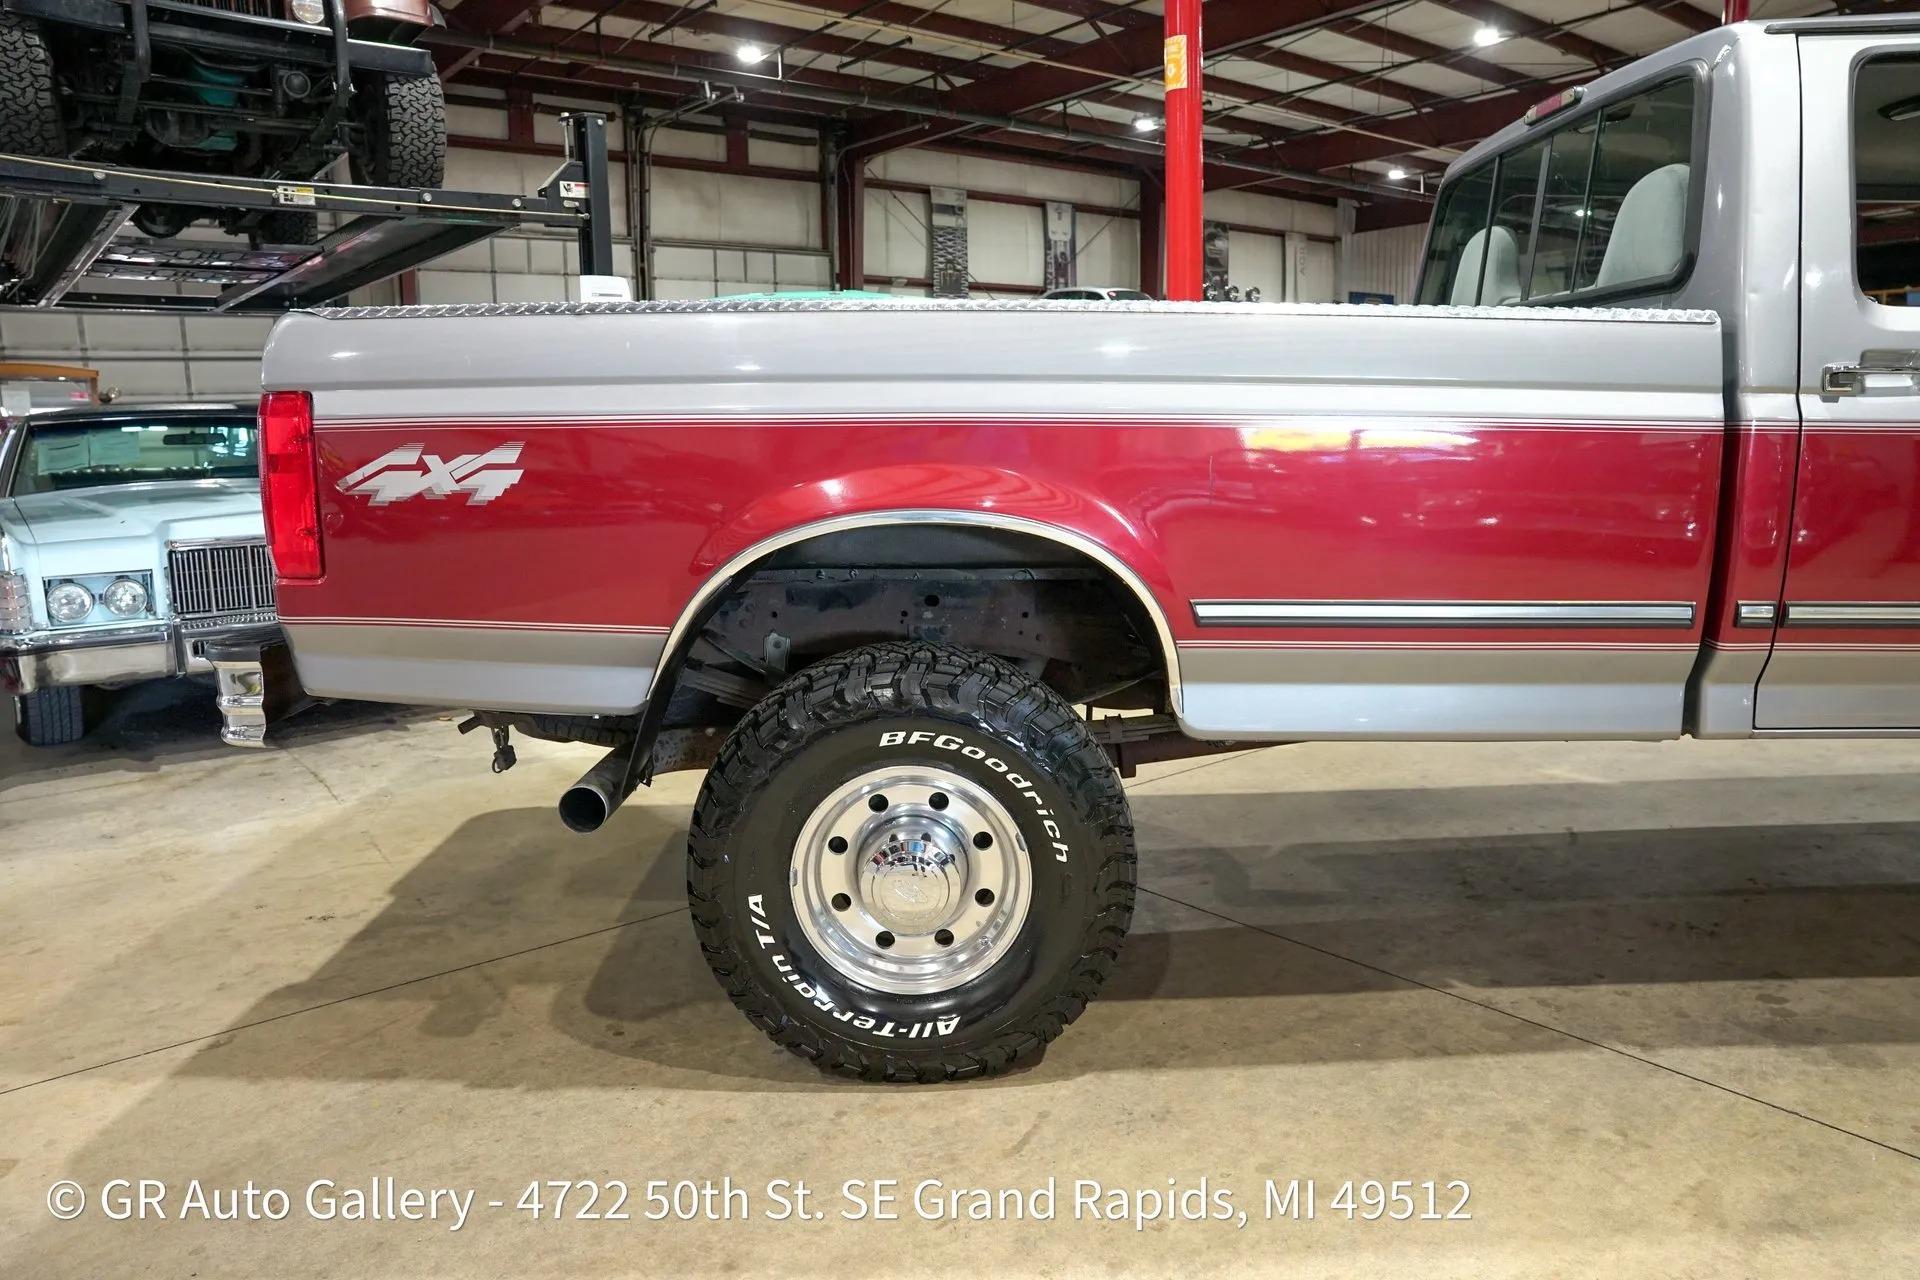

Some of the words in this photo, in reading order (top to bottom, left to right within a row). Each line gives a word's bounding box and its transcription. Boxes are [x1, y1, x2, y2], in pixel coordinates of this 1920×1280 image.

[878, 731, 1069, 864] BFGoodrich
[747, 894, 776, 951] T/A
[771, 954, 962, 1039] All-Terrain
